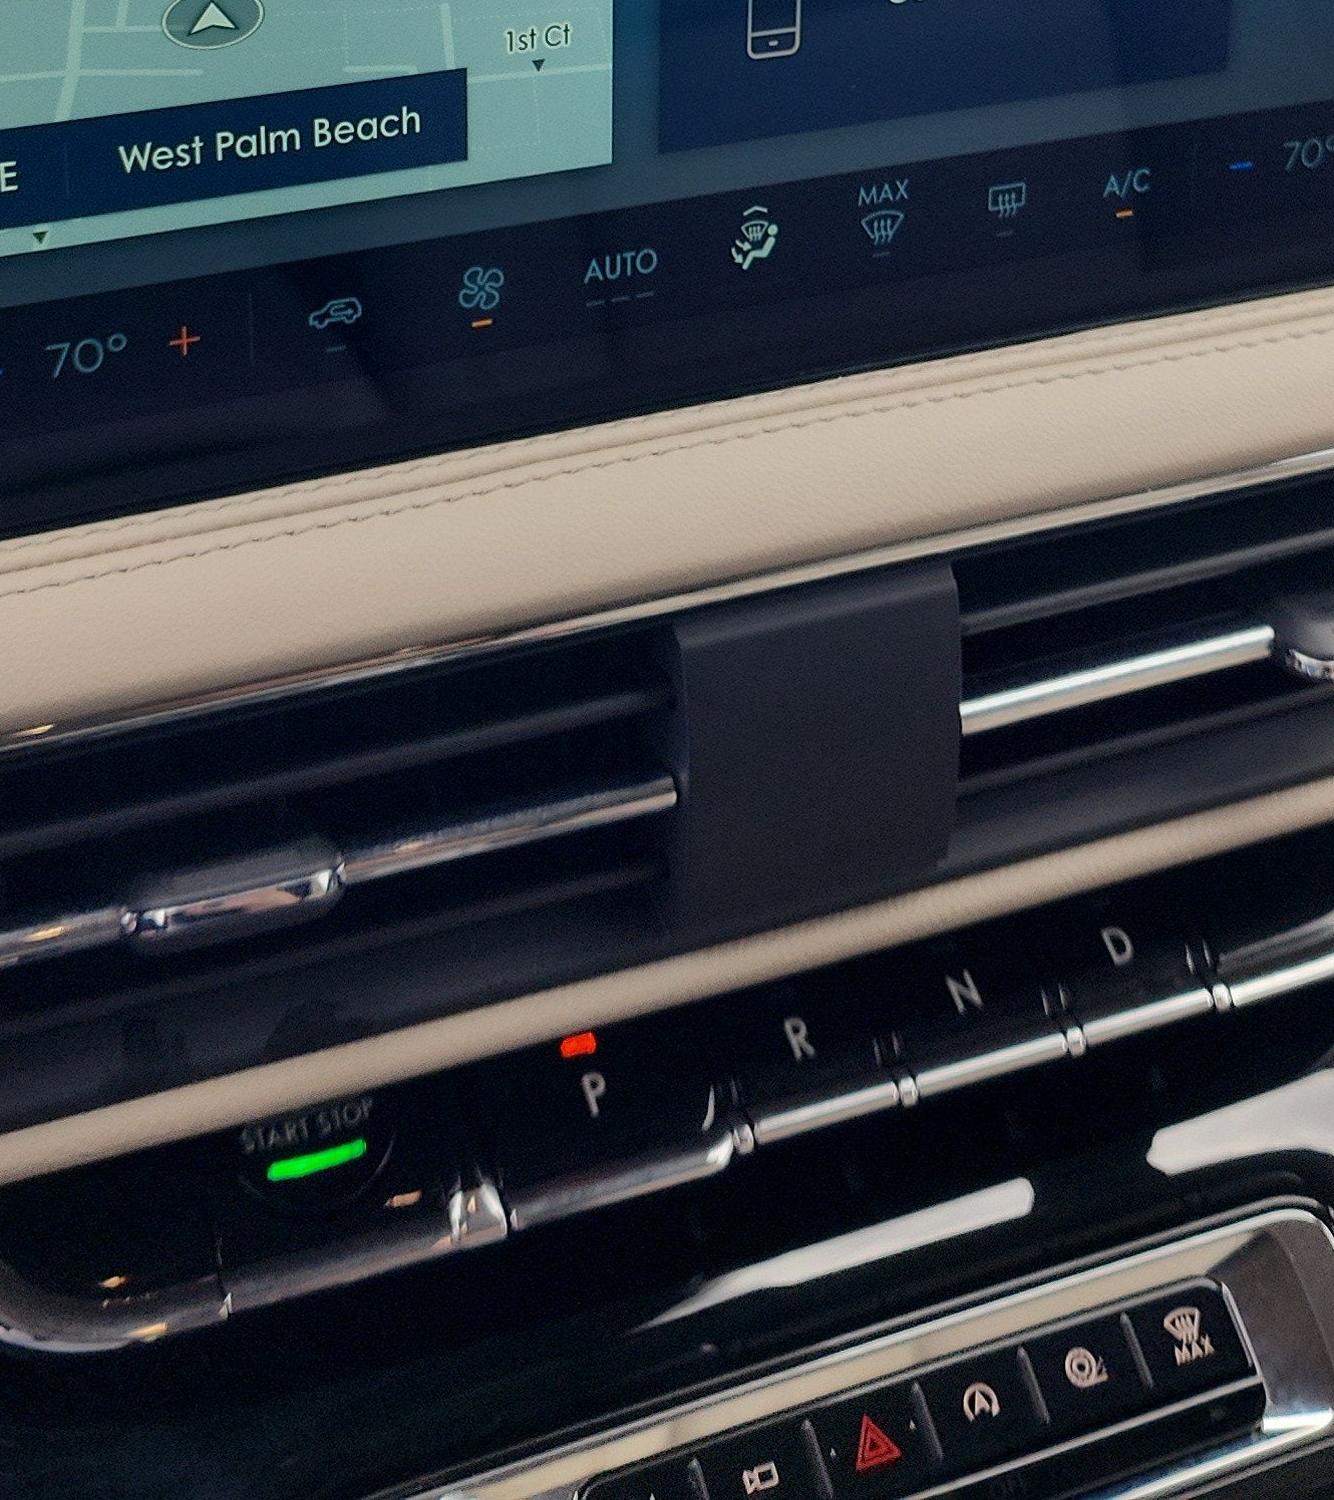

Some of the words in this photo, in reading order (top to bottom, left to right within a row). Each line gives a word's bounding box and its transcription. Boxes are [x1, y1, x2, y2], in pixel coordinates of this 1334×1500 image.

[506, 29, 536, 51] 1st
[544, 24, 571, 47] Ct
[118, 136, 204, 174] West
[215, 125, 301, 162] Palm
[313, 107, 421, 146] Beach
[858, 179, 909, 206] MAX
[1103, 167, 1150, 199] A/C
[583, 248, 658, 284] AUTO
[1101, 926, 1134, 967] D
[945, 968, 984, 1015] N
[783, 1017, 815, 1063] R
[582, 1072, 606, 1118] P
